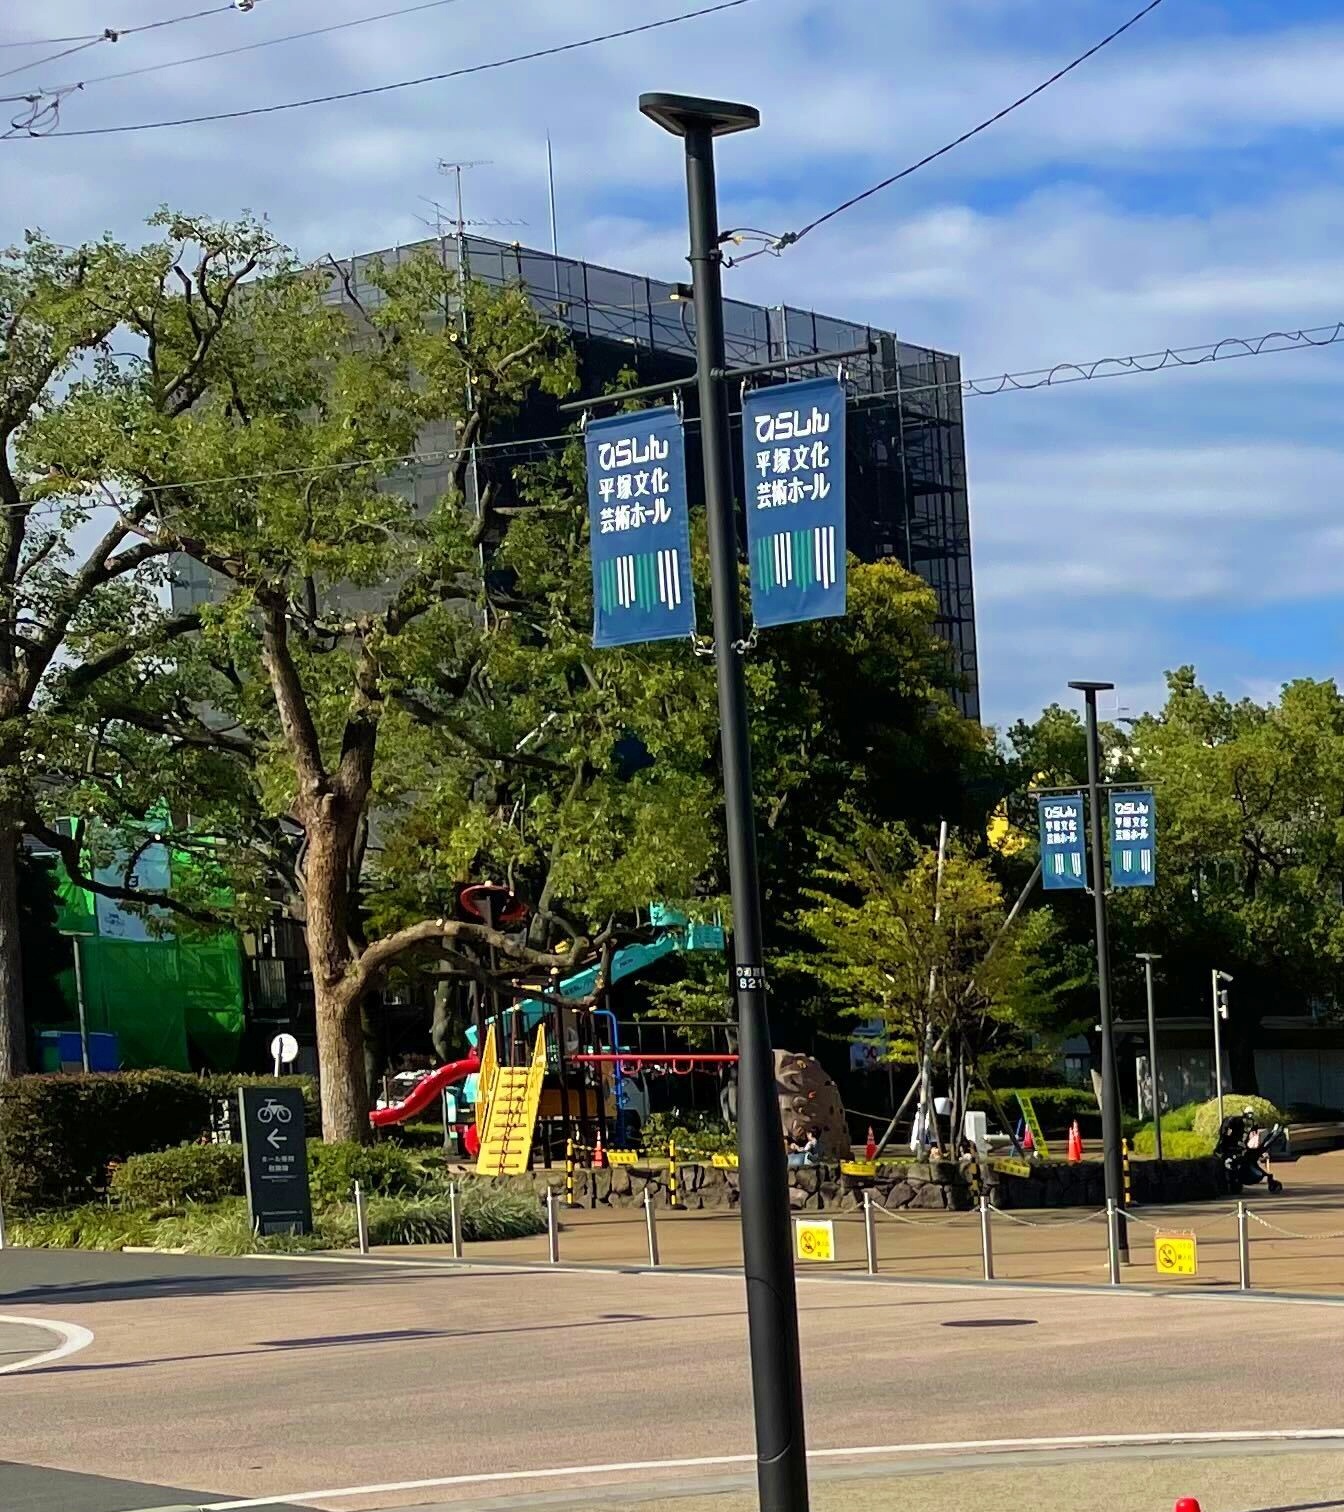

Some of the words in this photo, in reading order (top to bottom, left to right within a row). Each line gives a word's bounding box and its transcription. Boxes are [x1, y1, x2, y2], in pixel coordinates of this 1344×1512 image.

[755, 407, 830, 442] ひらしん
[598, 434, 669, 470] ひらしん
[755, 440, 830, 477] 平塚文化
[598, 467, 670, 502] 平塚文化
[756, 472, 831, 509] 芸術ホール
[600, 498, 672, 534] 芸術ホール
